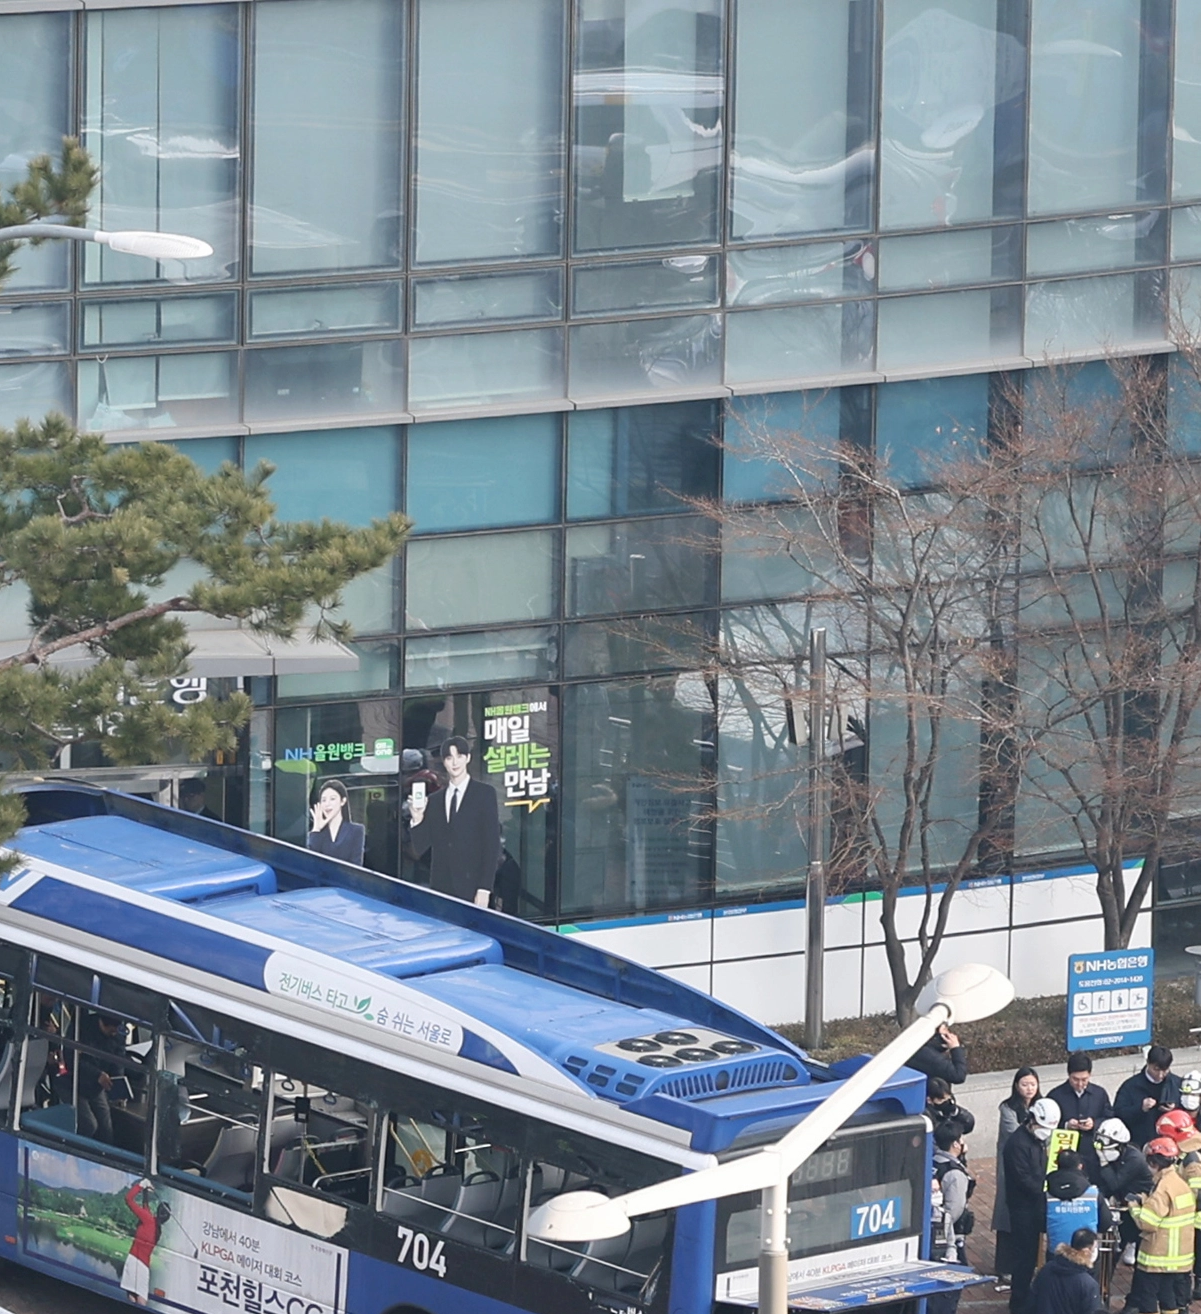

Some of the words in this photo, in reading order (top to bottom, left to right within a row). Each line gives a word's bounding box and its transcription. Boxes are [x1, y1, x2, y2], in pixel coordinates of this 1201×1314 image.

[484, 716, 530, 743] 매일
[483, 744, 551, 774] 설레는
[504, 769, 551, 798] 만남
[279, 971, 323, 1002] 전기버스
[326, 989, 350, 1009] 타고
[376, 1008, 389, 1026] 숨
[392, 1012, 415, 1035] 쉬는
[418, 1020, 452, 1046] 서울로
[856, 1200, 895, 1236] 704
[202, 1221, 237, 1245] 강남에서
[238, 1235, 261, 1253] 40분
[397, 1225, 447, 1278] 704
[201, 1241, 235, 1264] KLPGA
[236, 1253, 263, 1275] 메이저
[264, 1263, 283, 1282] 대회
[284, 1271, 303, 1287] 코스
[822, 1263, 846, 1275] KLPGA
